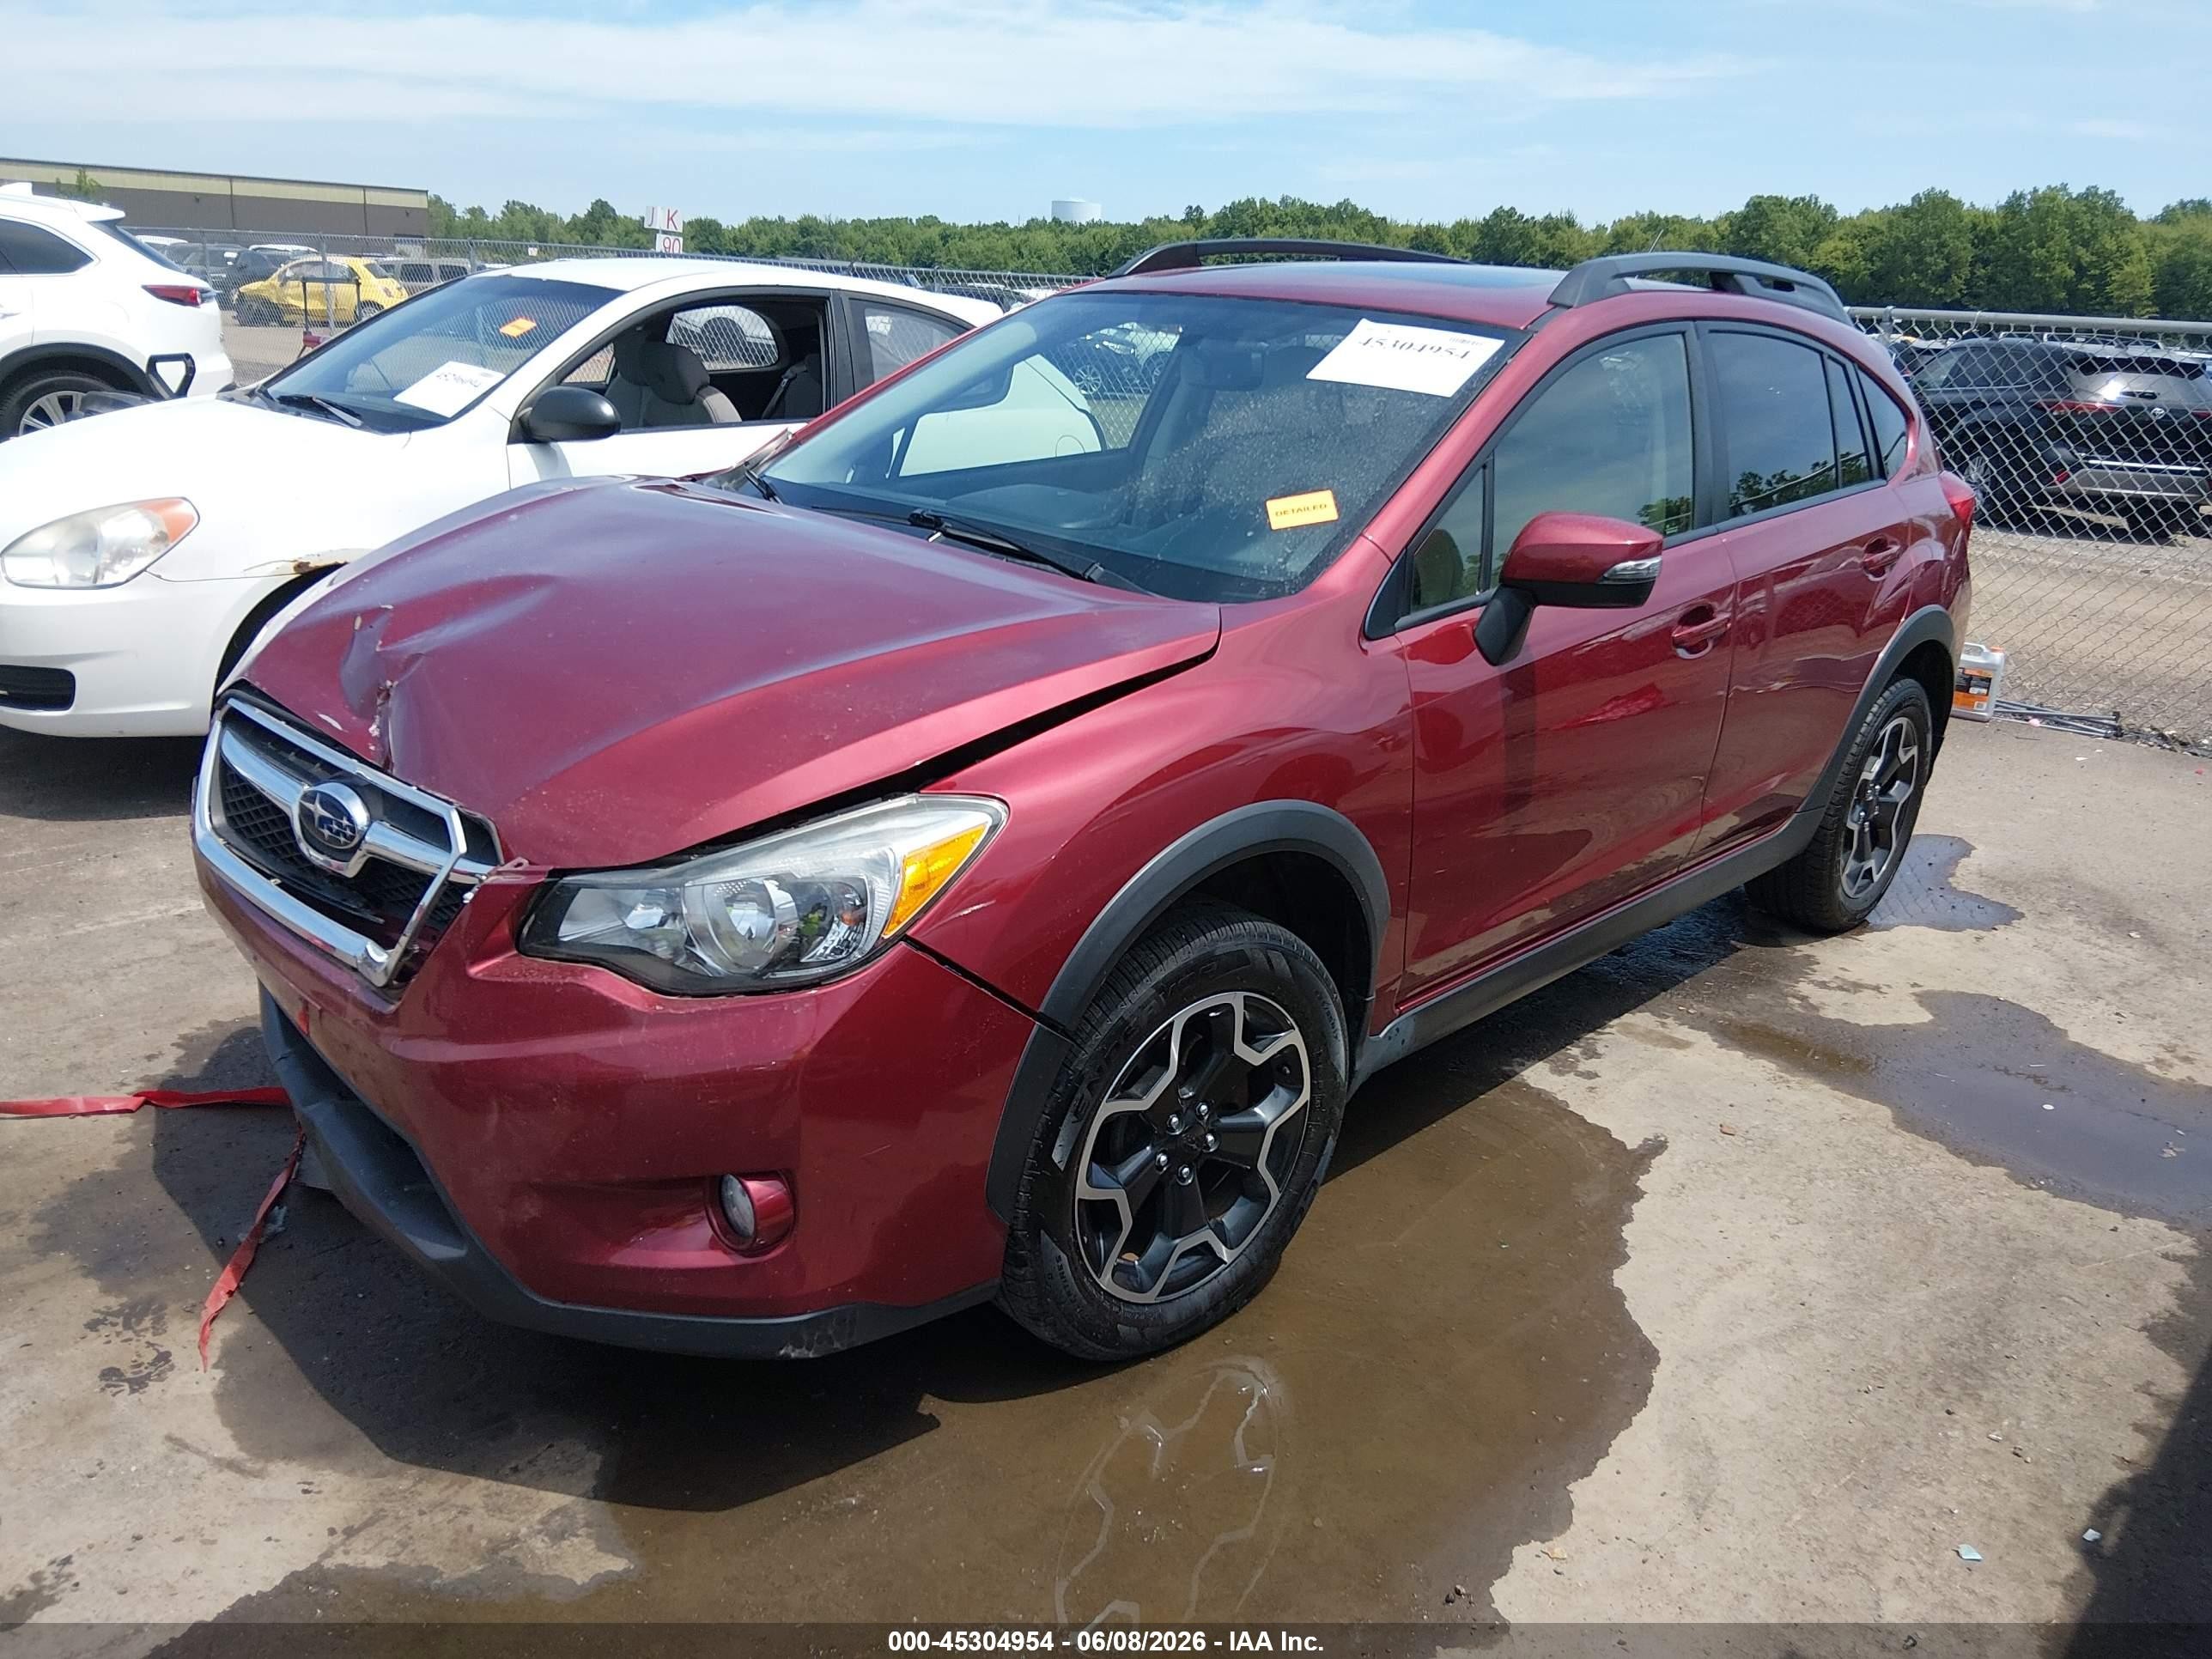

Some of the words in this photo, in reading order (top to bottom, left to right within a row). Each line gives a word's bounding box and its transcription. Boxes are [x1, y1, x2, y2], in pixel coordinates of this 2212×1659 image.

[666, 209, 678, 231] K
[663, 236, 681, 253] 90
[1359, 336, 1470, 360] 45304954
[1275, 504, 1328, 517] DETAILED
